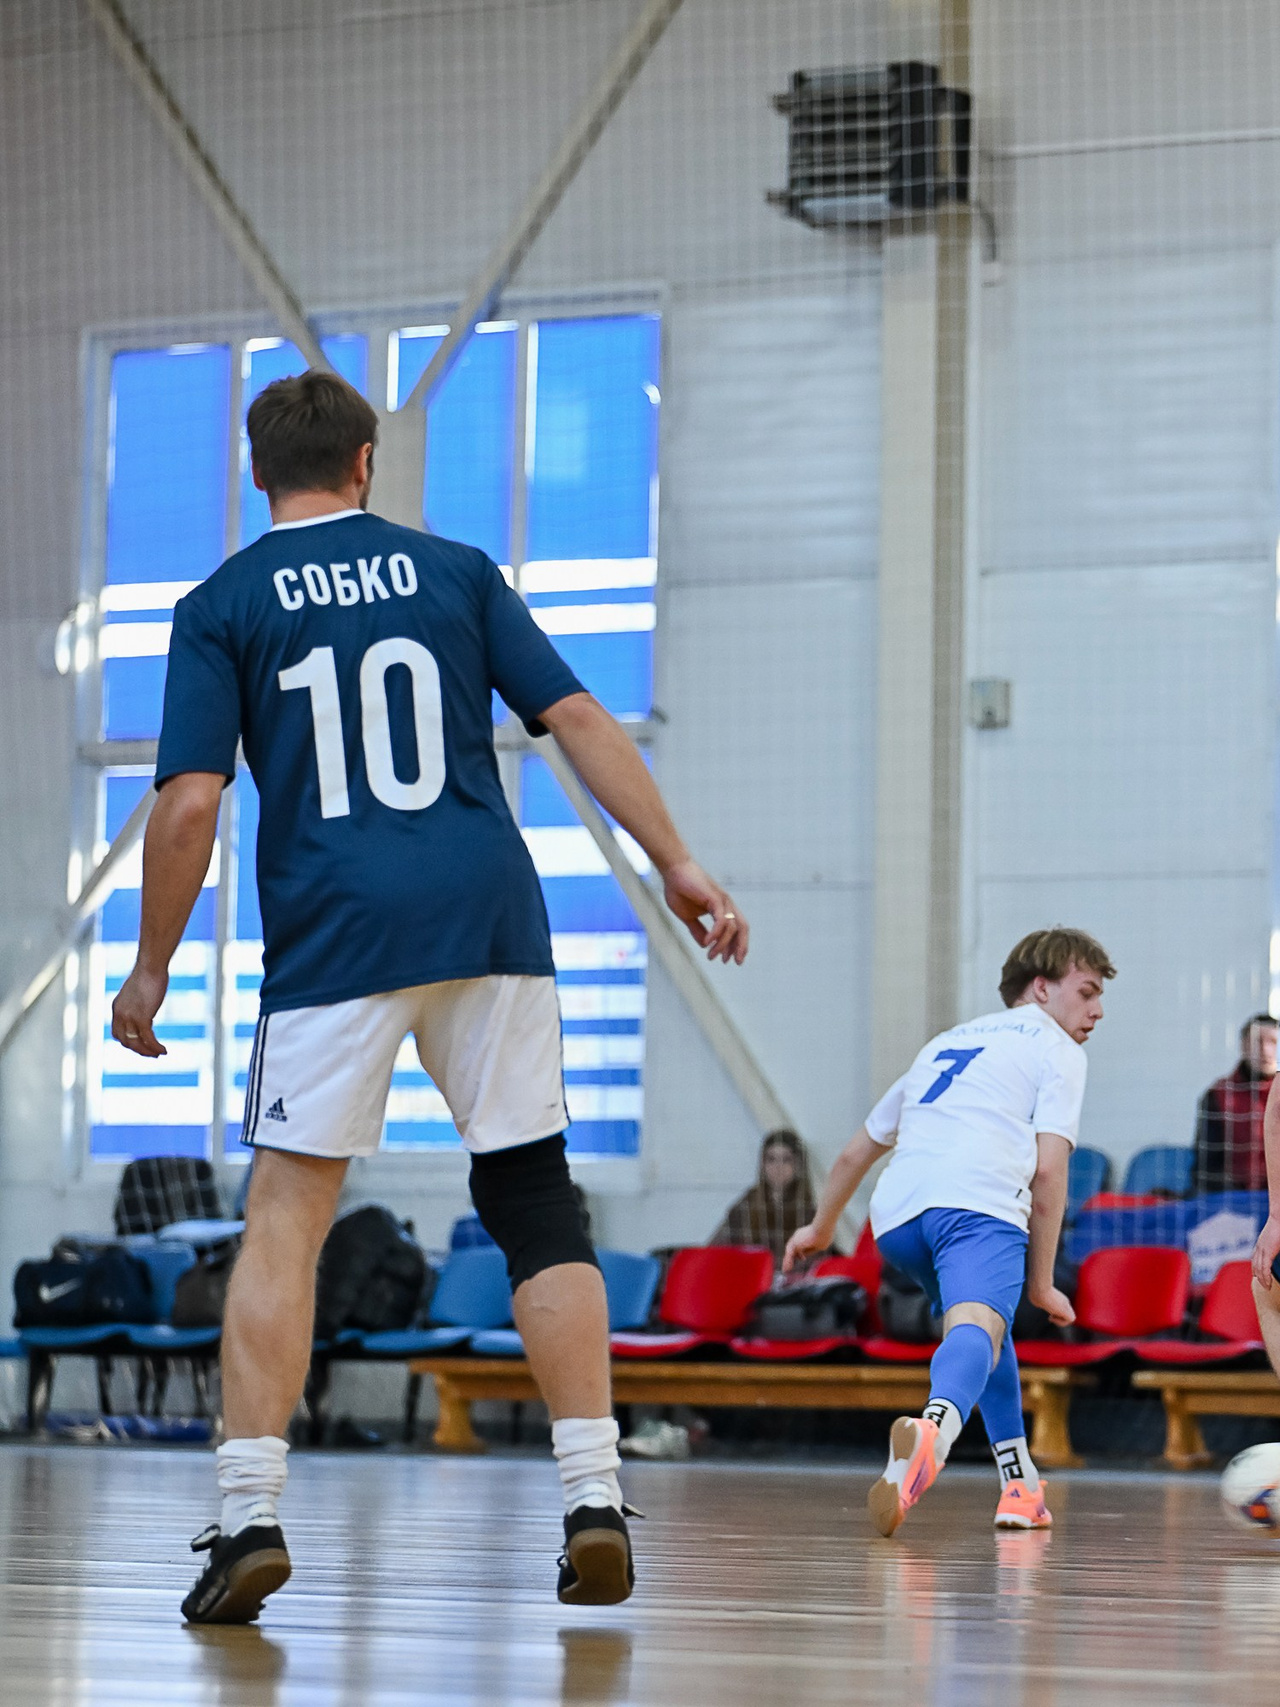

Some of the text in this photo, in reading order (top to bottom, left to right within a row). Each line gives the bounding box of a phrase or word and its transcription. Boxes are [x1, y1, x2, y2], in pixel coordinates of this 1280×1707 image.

[273, 553, 418, 611] СОБКО
[278, 637, 447, 819] 10
[918, 1047, 985, 1104] 7
